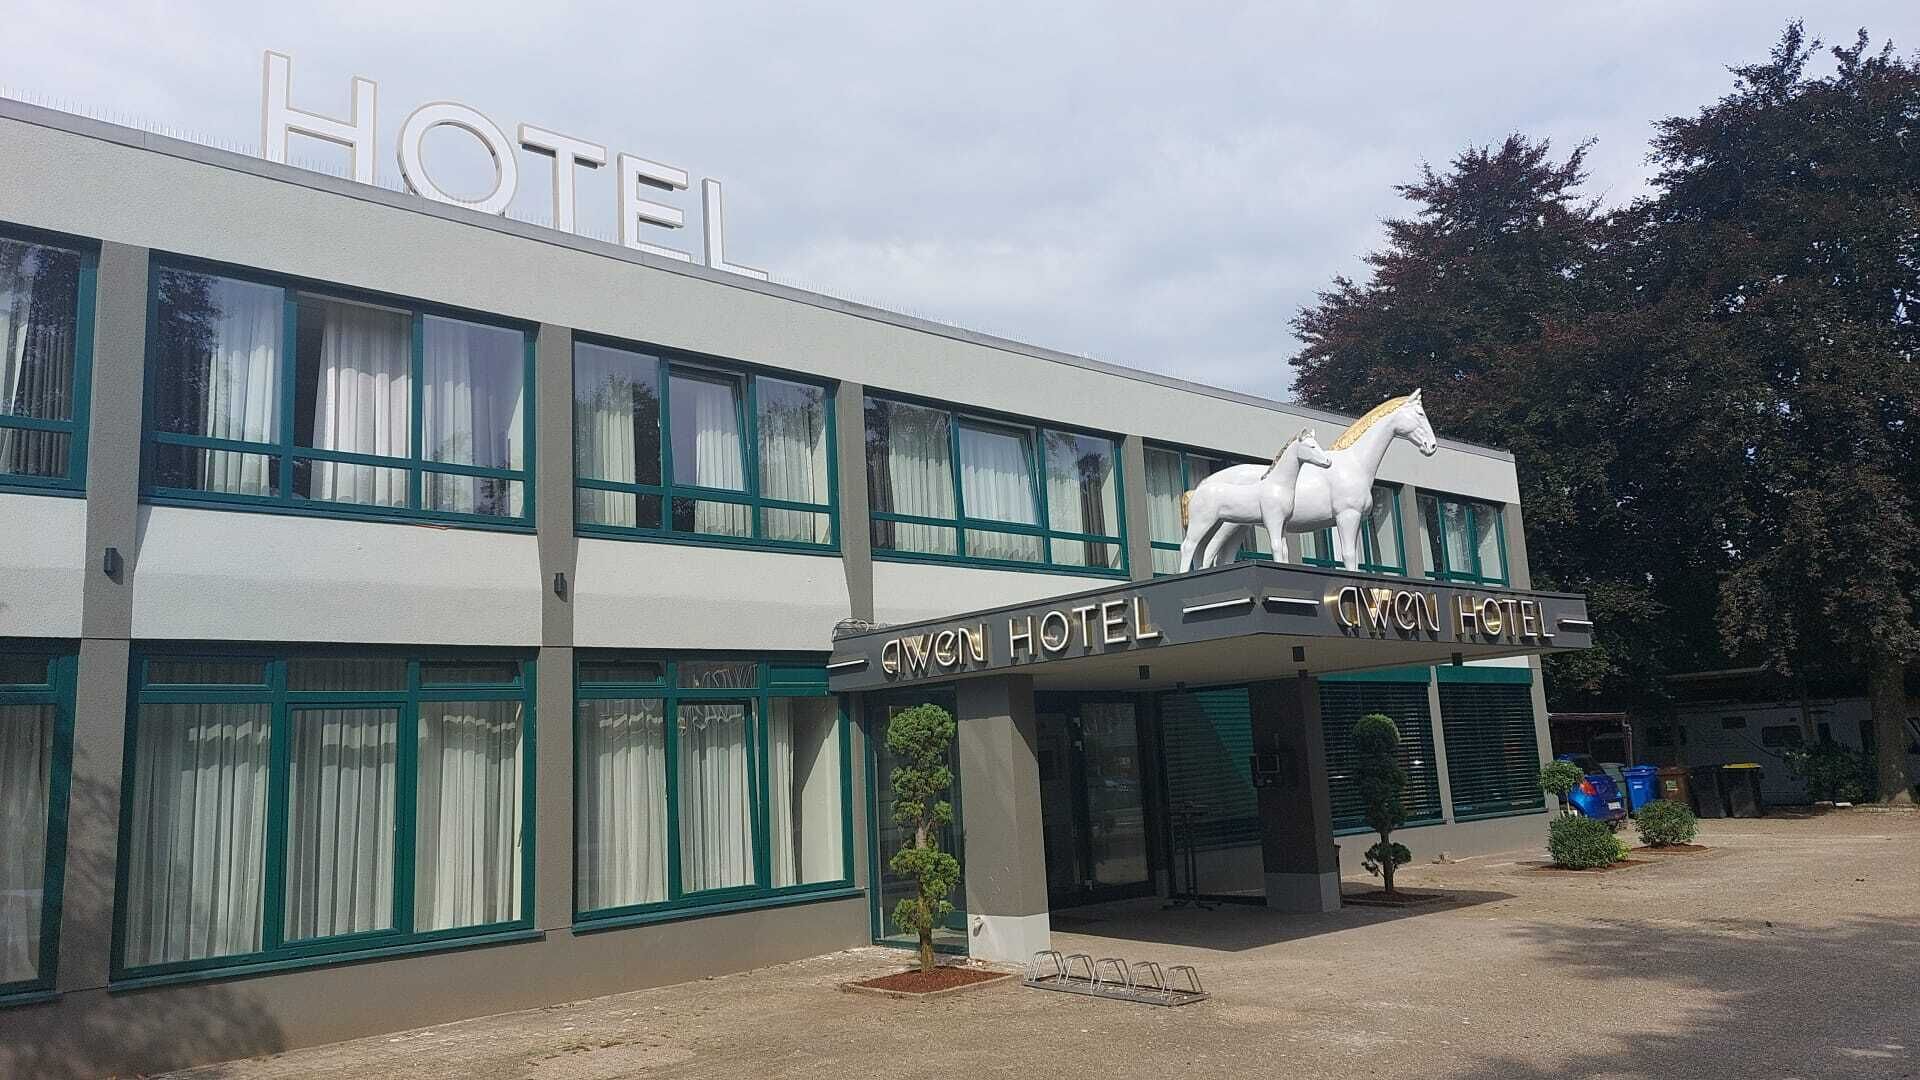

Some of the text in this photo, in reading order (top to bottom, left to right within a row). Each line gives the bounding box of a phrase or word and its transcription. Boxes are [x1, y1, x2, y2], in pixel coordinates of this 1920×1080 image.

[262, 50, 769, 281] HOTEL
[1008, 596, 1160, 657] HOTEL
[1457, 595, 1556, 638] HOTEL
